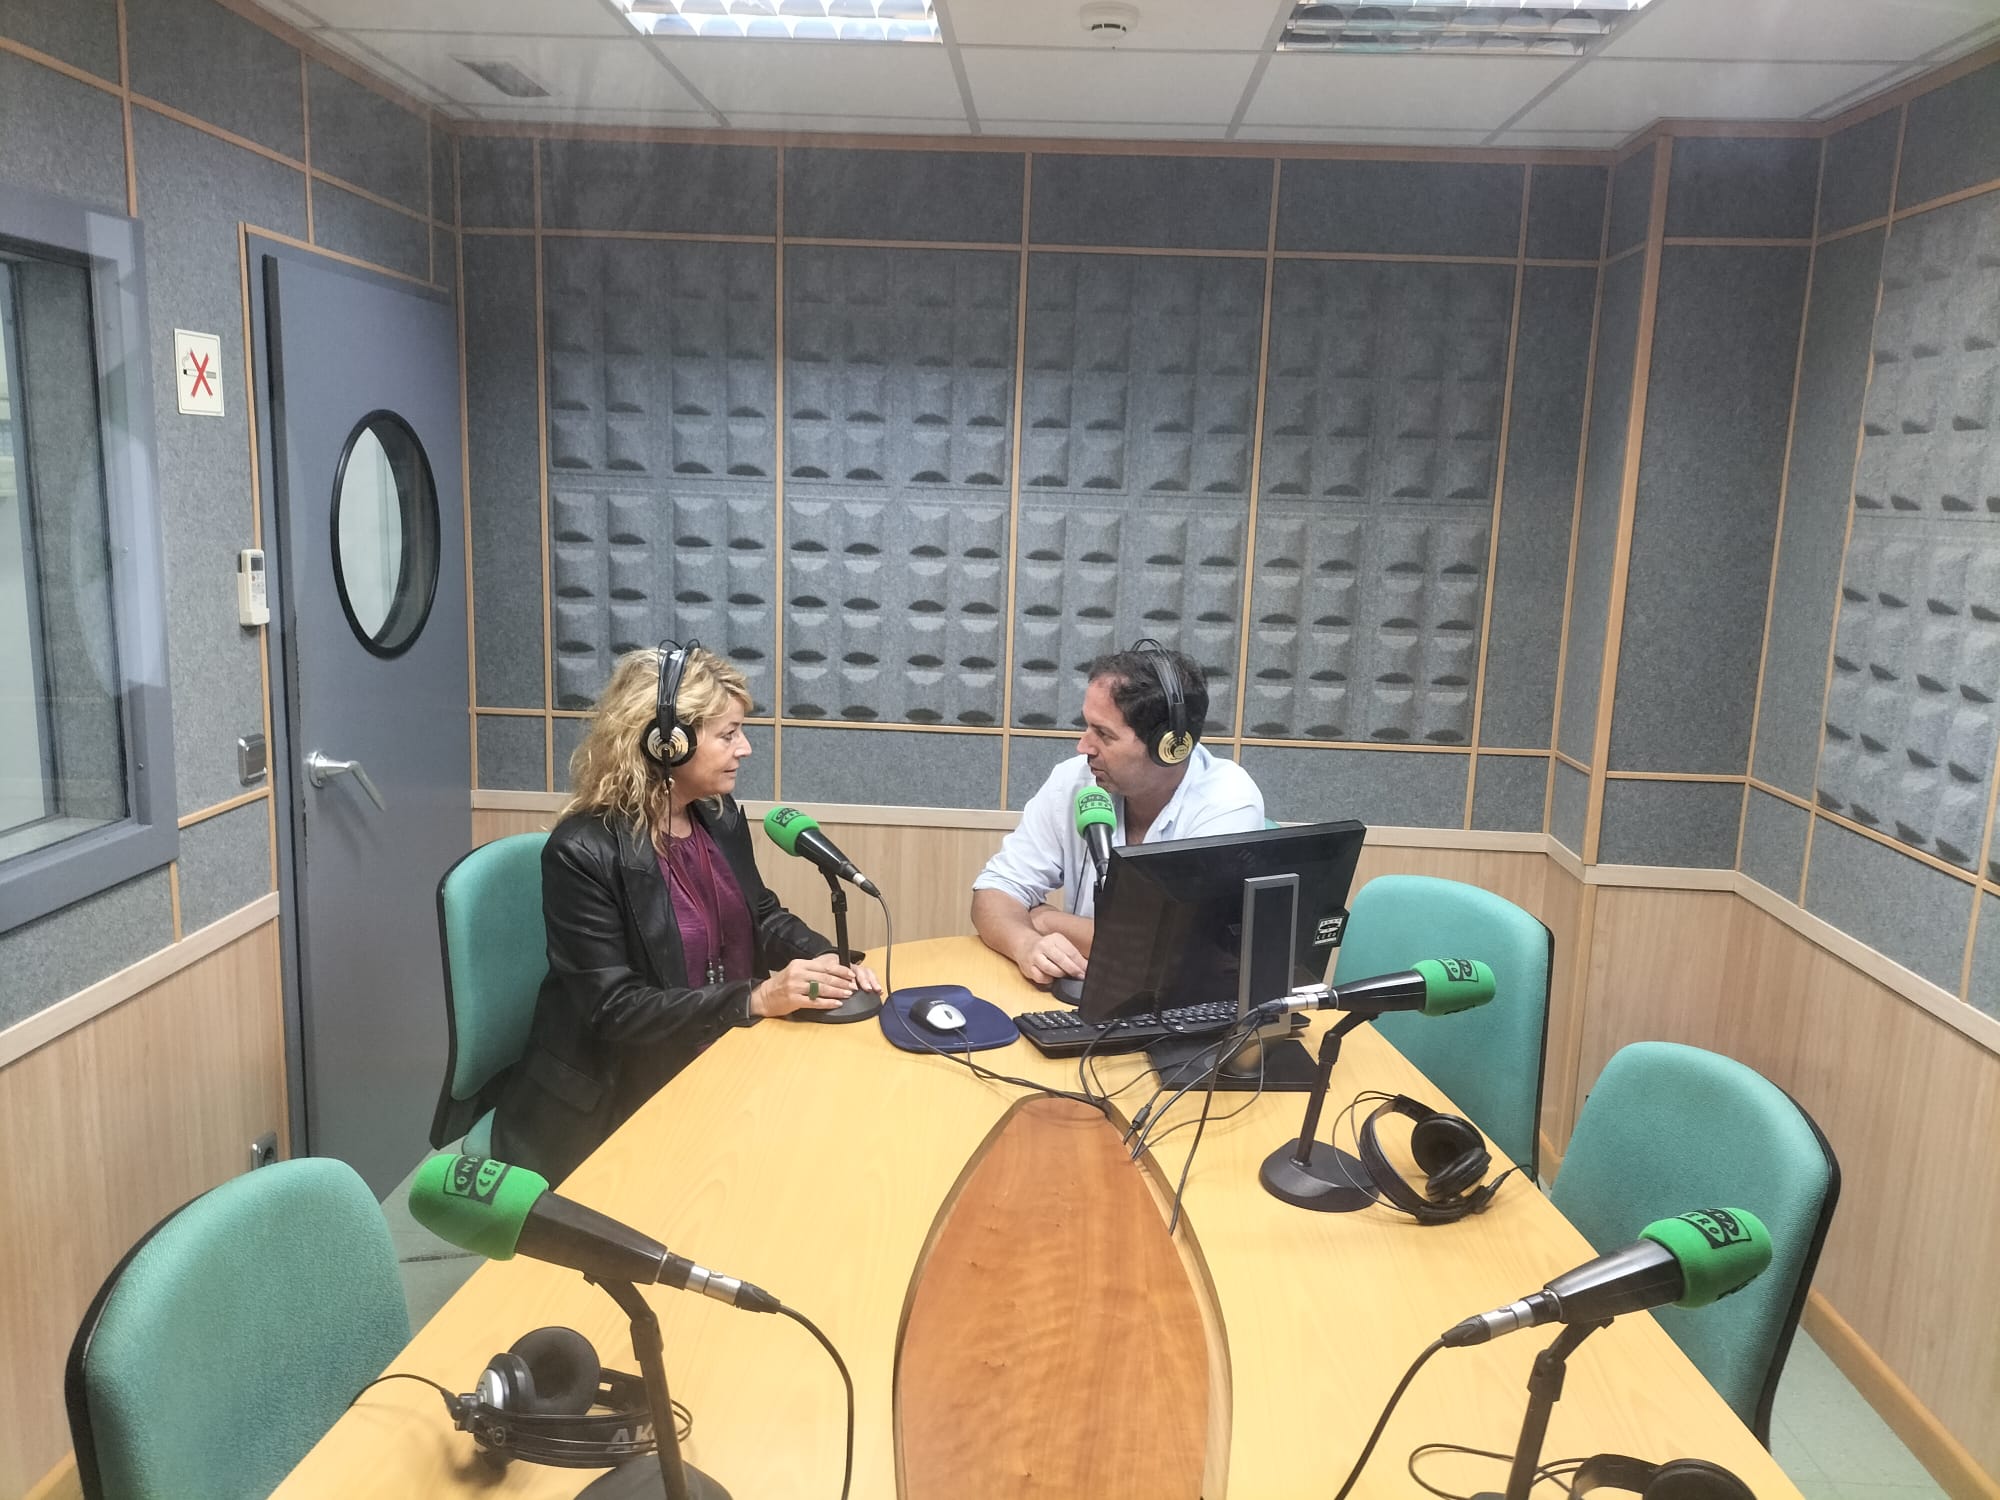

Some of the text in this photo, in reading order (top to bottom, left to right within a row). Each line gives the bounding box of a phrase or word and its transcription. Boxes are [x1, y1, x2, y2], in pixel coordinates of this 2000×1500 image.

[479, 1160, 502, 1187] CER
[1686, 1213, 1720, 1235] ERO
[606, 1422, 657, 1453] AK
